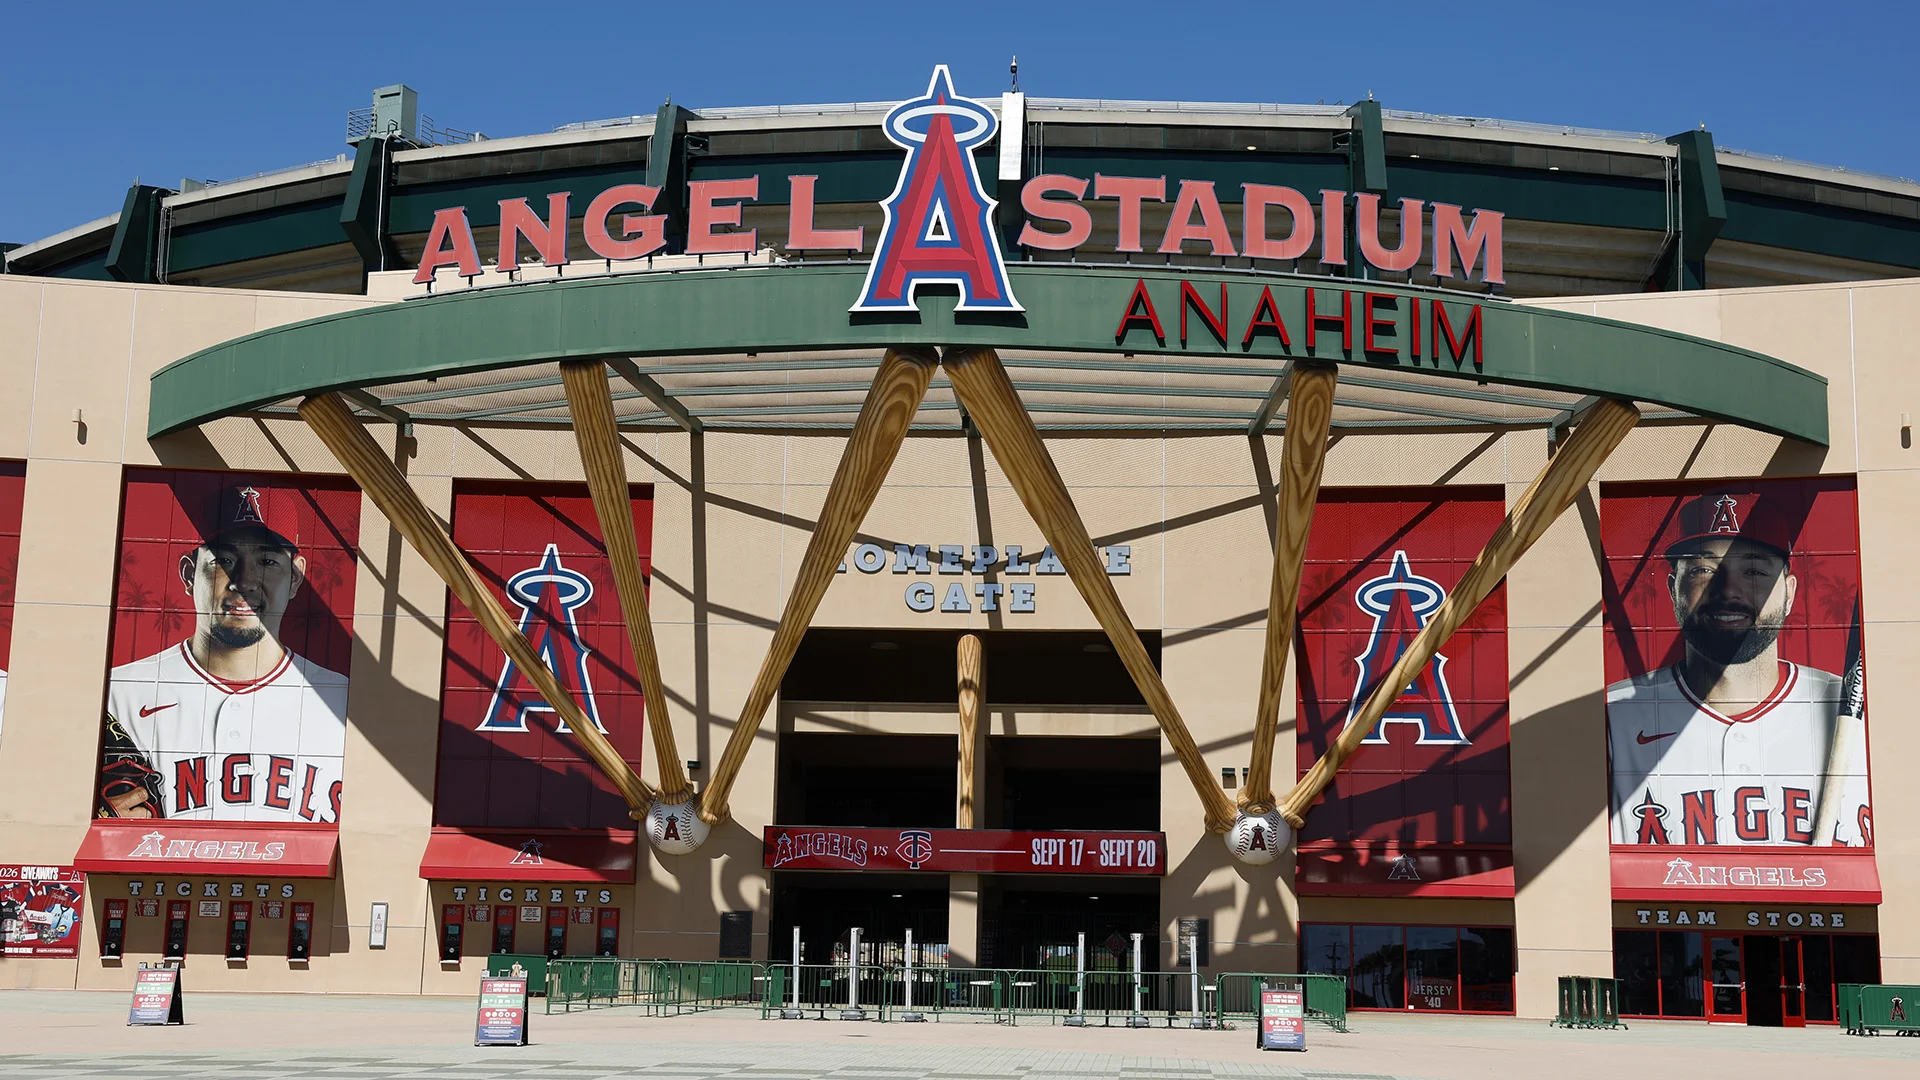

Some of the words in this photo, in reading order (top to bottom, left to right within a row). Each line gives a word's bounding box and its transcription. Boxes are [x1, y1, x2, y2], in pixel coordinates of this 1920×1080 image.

[1016, 171, 1508, 286] STADIUM
[1114, 277, 1485, 374] ANAHEIM
[836, 543, 1132, 576] OMEPLAE
[904, 581, 1036, 614] GATE
[128, 831, 285, 862] ANGELS
[773, 832, 867, 869] ANGELS
[873, 845, 889, 858] vs
[1031, 838, 1066, 866] SEPT
[1069, 838, 1083, 867] 17
[1099, 839, 1134, 867] SEPT
[1137, 840, 1156, 868] 20
[21, 866, 59, 881] GIVEAWAYS
[1662, 857, 1827, 887] ANGELS
[128, 881, 294, 898] TICKETS
[453, 886, 612, 904] TICKETS
[1636, 909, 1717, 926] TEAM
[1747, 911, 1845, 928] STORE
[1413, 985, 1453, 996] JERSEY
